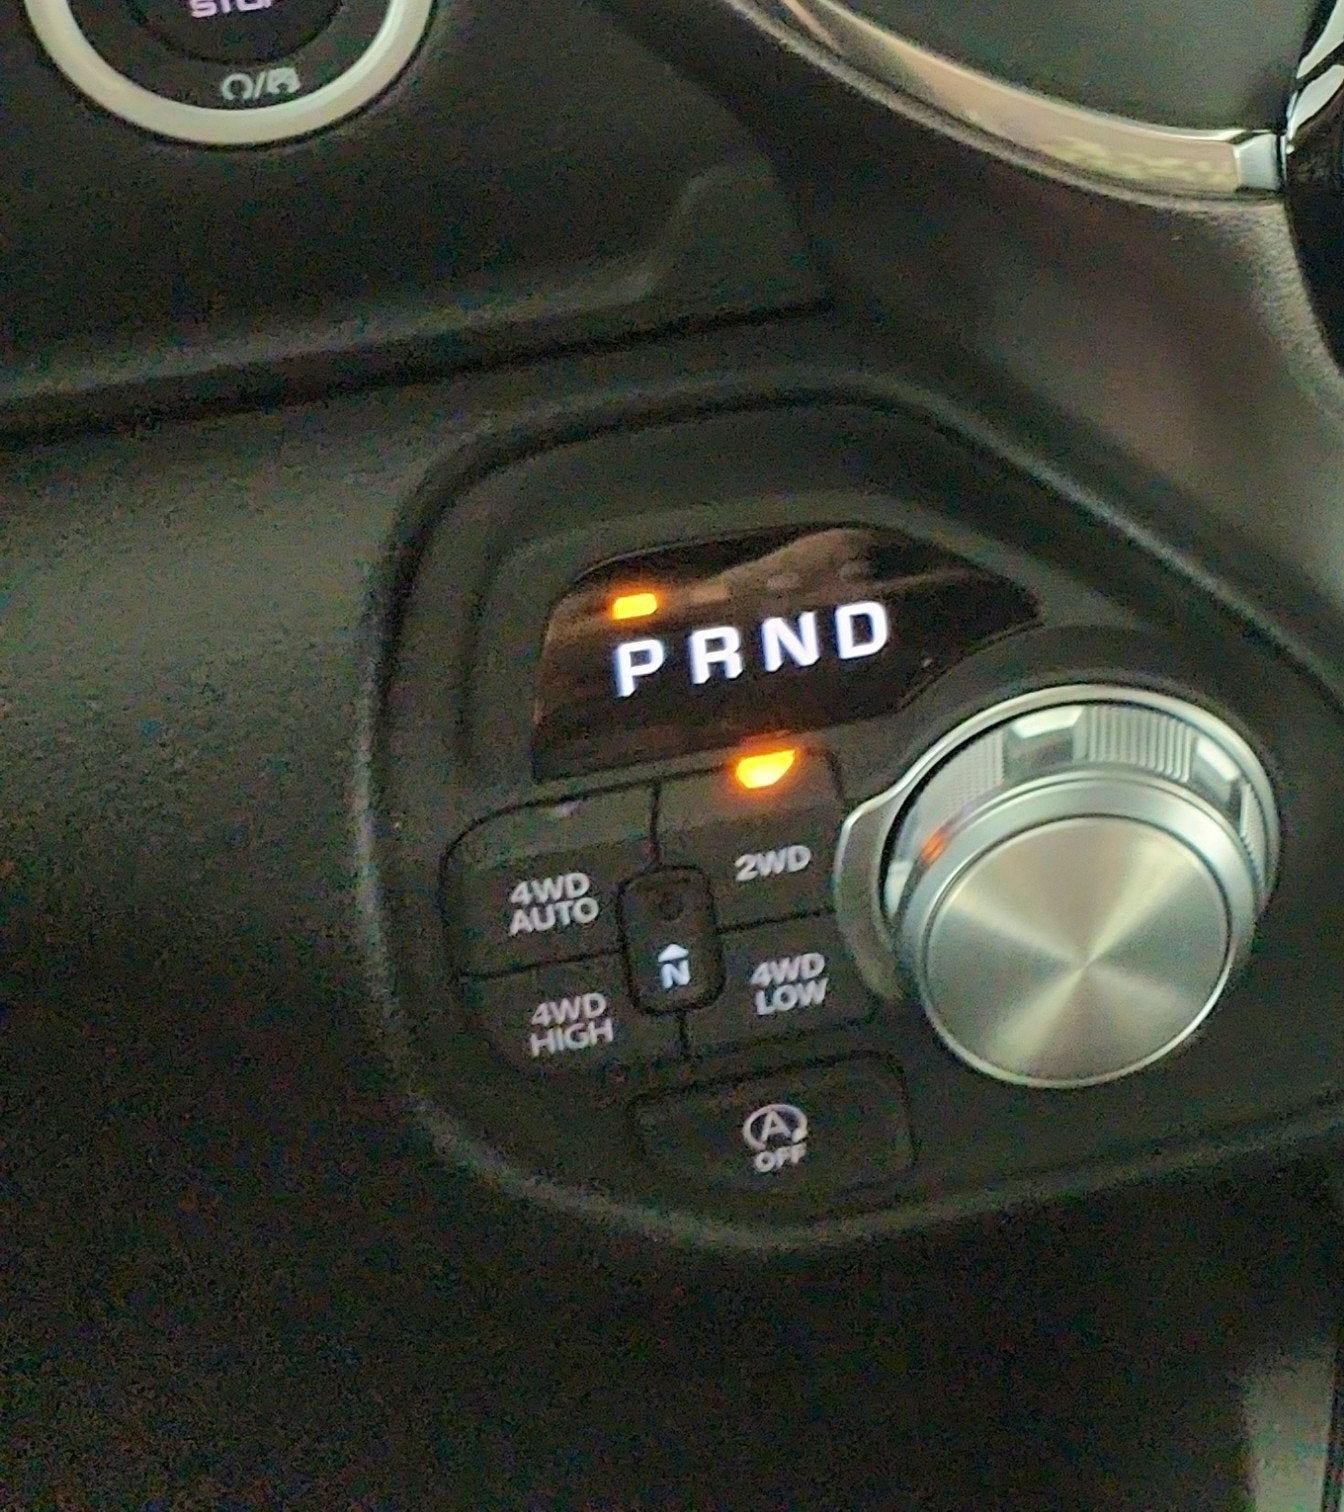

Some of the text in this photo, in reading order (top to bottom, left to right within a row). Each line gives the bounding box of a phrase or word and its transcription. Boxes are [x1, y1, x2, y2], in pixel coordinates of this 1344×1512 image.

[734, 844, 812, 883] 2WD
[510, 872, 590, 906] 4WD
[508, 897, 600, 937] AUTO
[659, 960, 691, 989] N
[749, 952, 826, 988] 4WD
[531, 992, 607, 1029] 4WD
[755, 977, 829, 1016] LOW
[529, 1018, 615, 1058] HIGH
[752, 1143, 807, 1173] OFF
